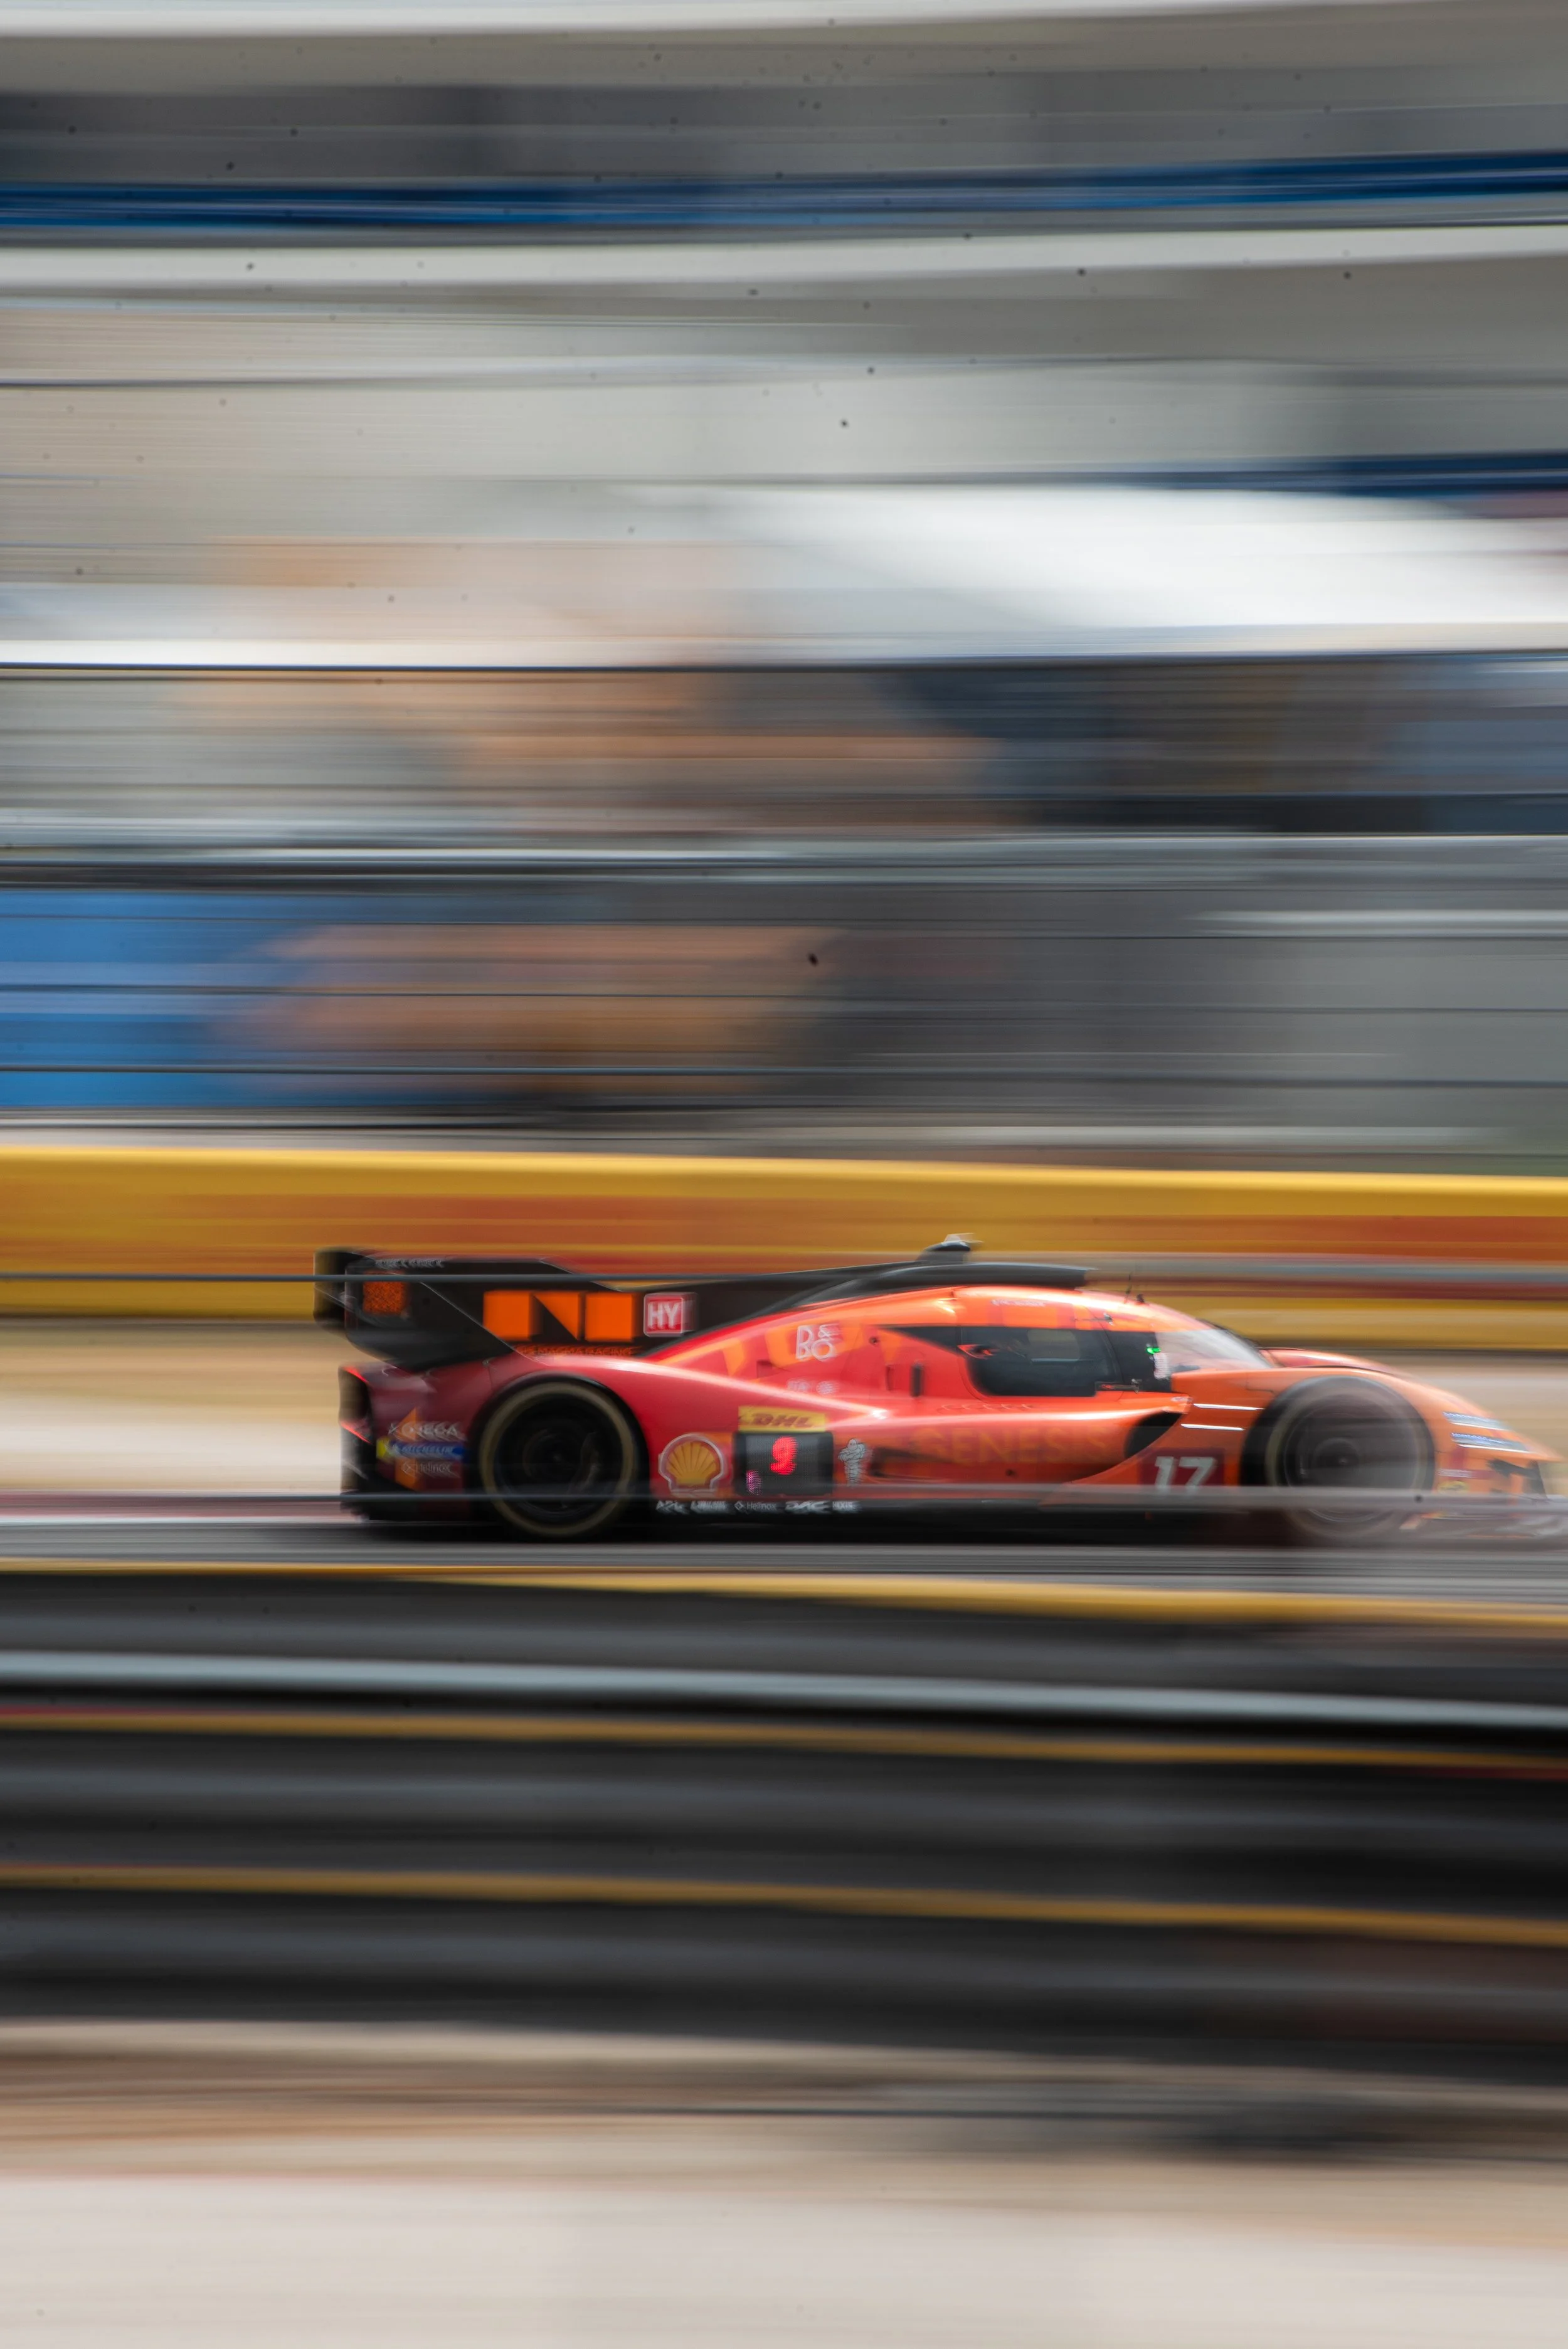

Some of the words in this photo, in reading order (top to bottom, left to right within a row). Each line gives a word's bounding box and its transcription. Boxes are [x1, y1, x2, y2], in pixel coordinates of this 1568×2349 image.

[647, 1302, 680, 1328] HY
[752, 1413, 813, 1428] DHL
[1154, 1456, 1215, 1489] 17
